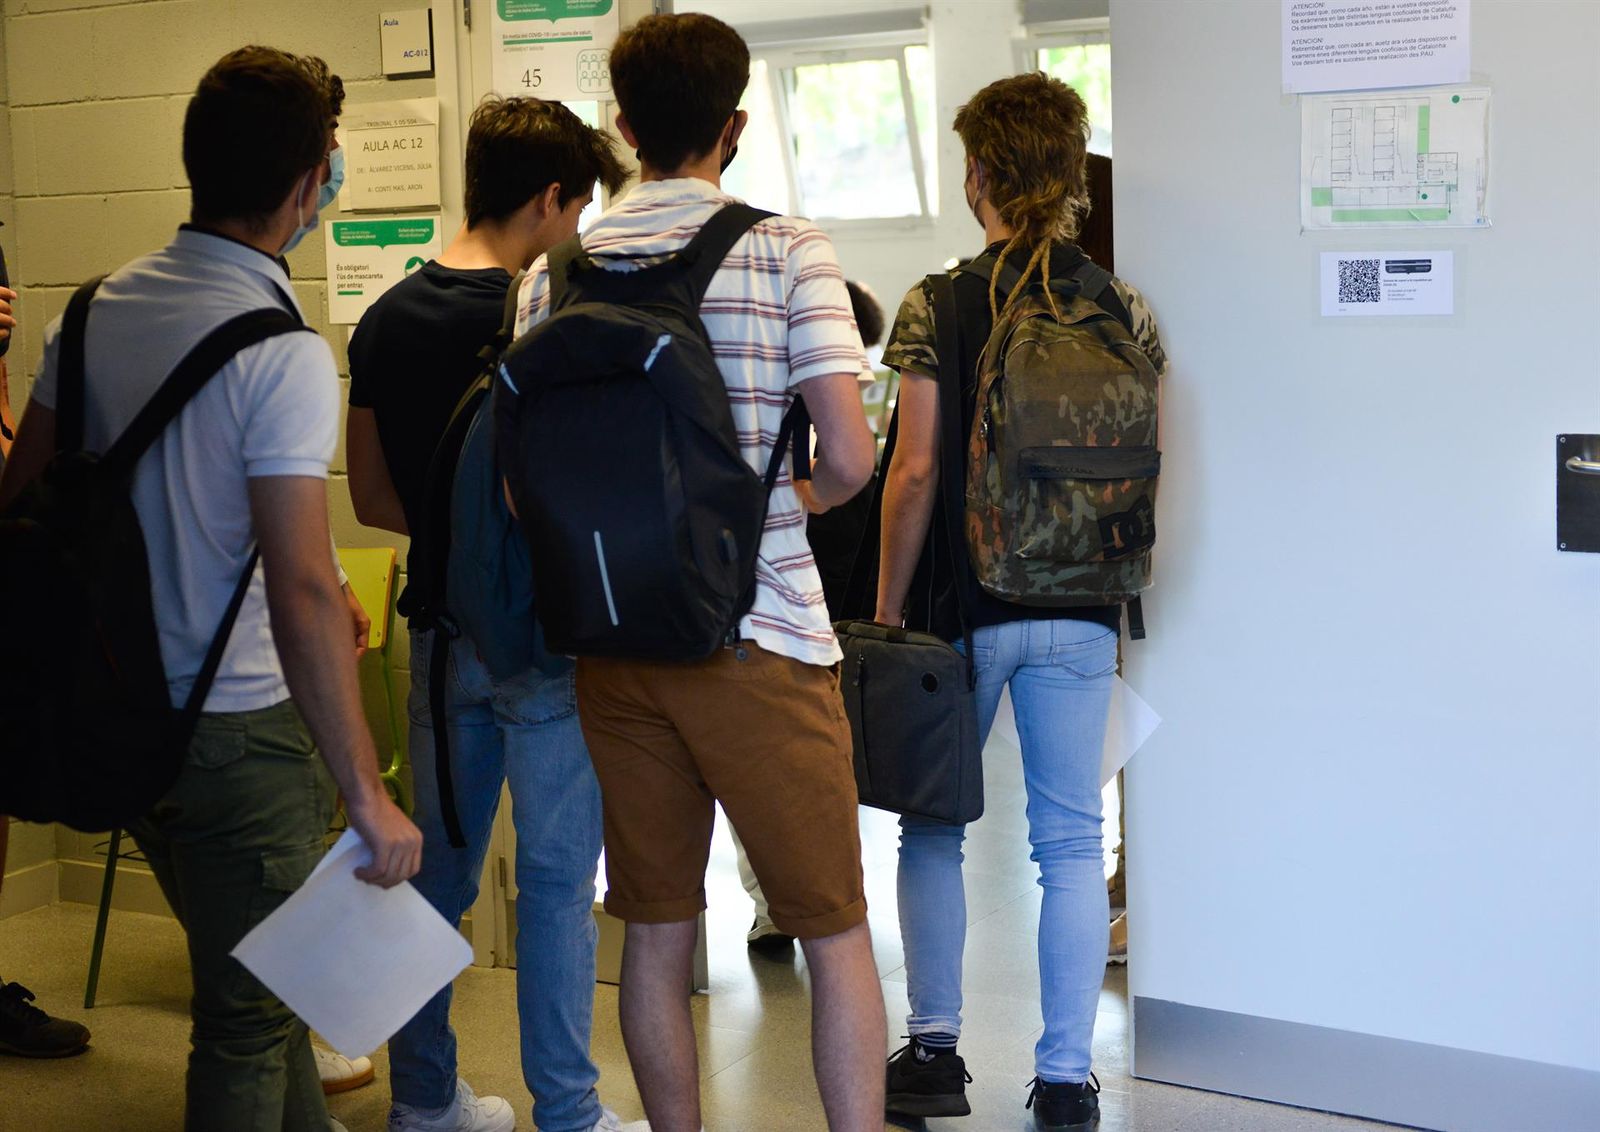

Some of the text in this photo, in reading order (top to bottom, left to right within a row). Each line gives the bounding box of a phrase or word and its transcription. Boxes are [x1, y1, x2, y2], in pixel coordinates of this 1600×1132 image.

[403, 49, 428, 57] AC-012
[521, 69, 542, 88] 45
[363, 137, 423, 152] AULA AC 12
[344, 264, 370, 272] obligatori
